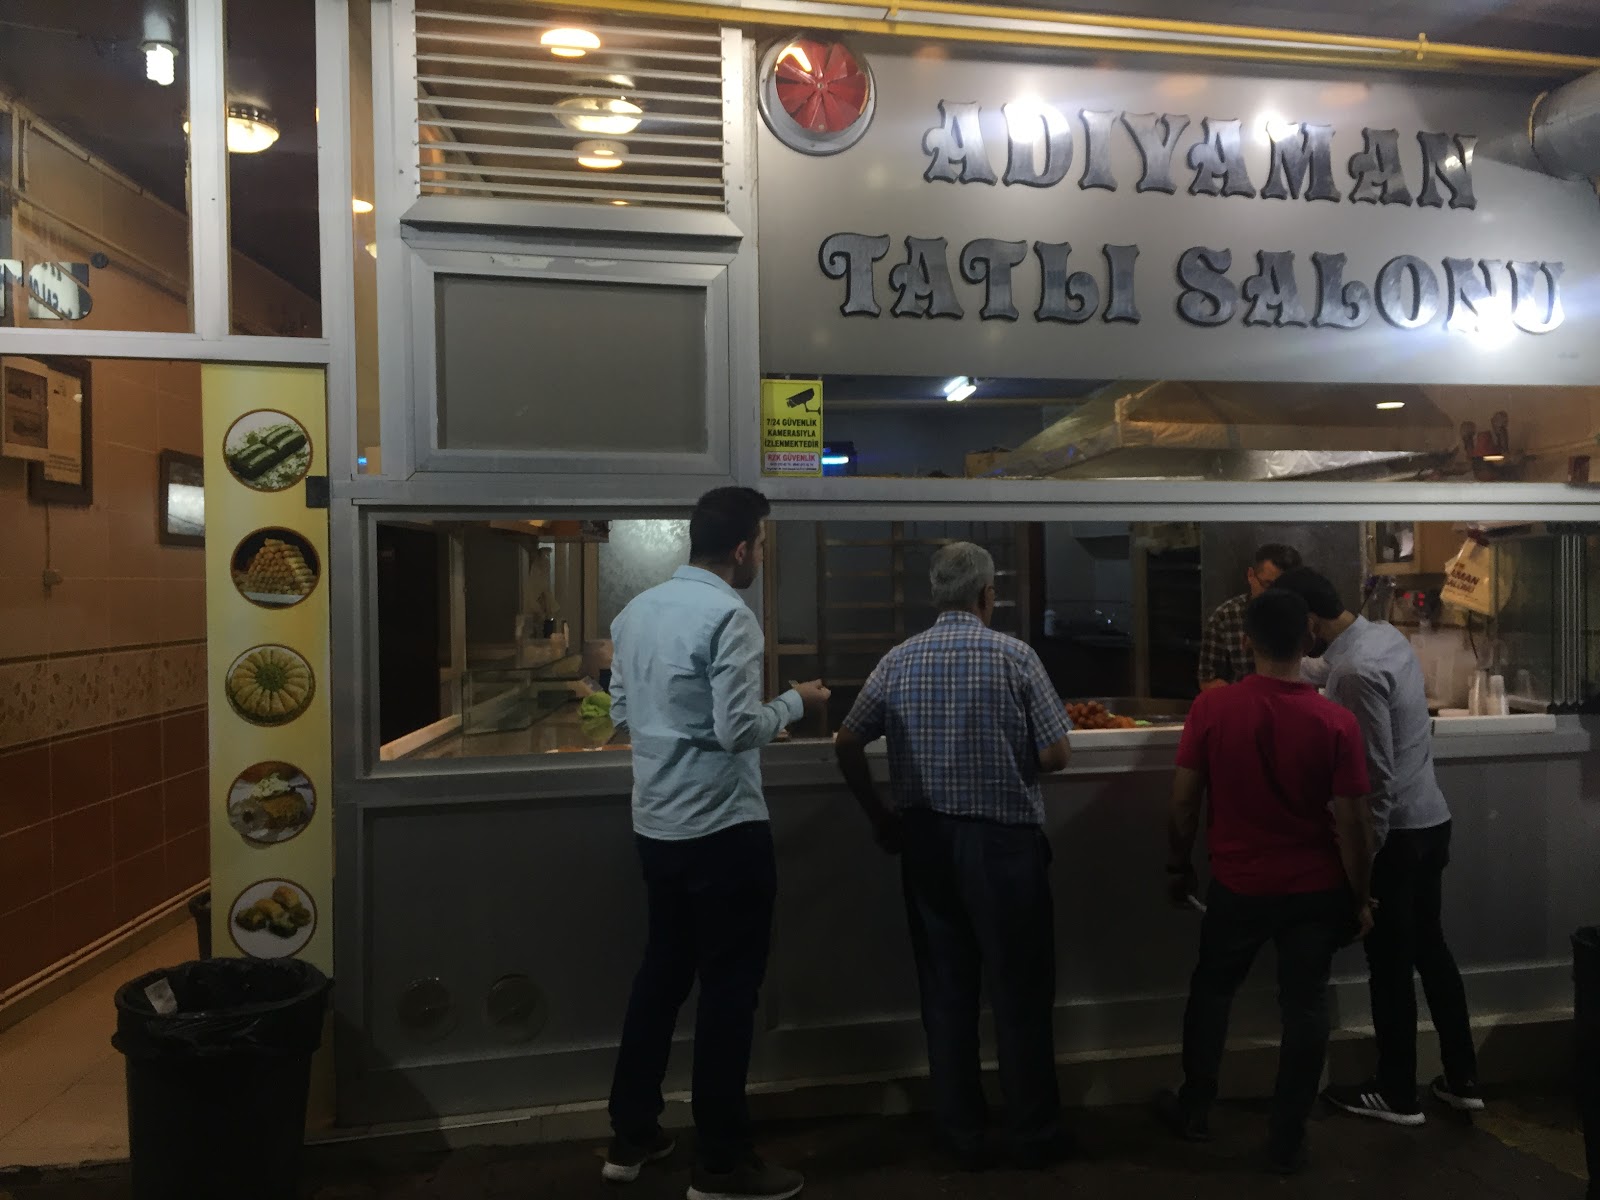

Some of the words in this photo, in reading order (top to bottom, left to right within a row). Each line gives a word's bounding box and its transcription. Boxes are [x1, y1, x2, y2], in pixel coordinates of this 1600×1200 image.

[922, 99, 1478, 210] ADIYAMAN
[819, 232, 1141, 324] TATLI
[1175, 247, 1565, 334] SALONU
[766, 418, 780, 426] 7/24
[782, 417, 817, 426] GÜVENLİK
[767, 429, 816, 437] KAMERASIYLA
[764, 439, 819, 448] İZLENMEKTEDİR
[782, 453, 815, 461] GÜVENLİK
